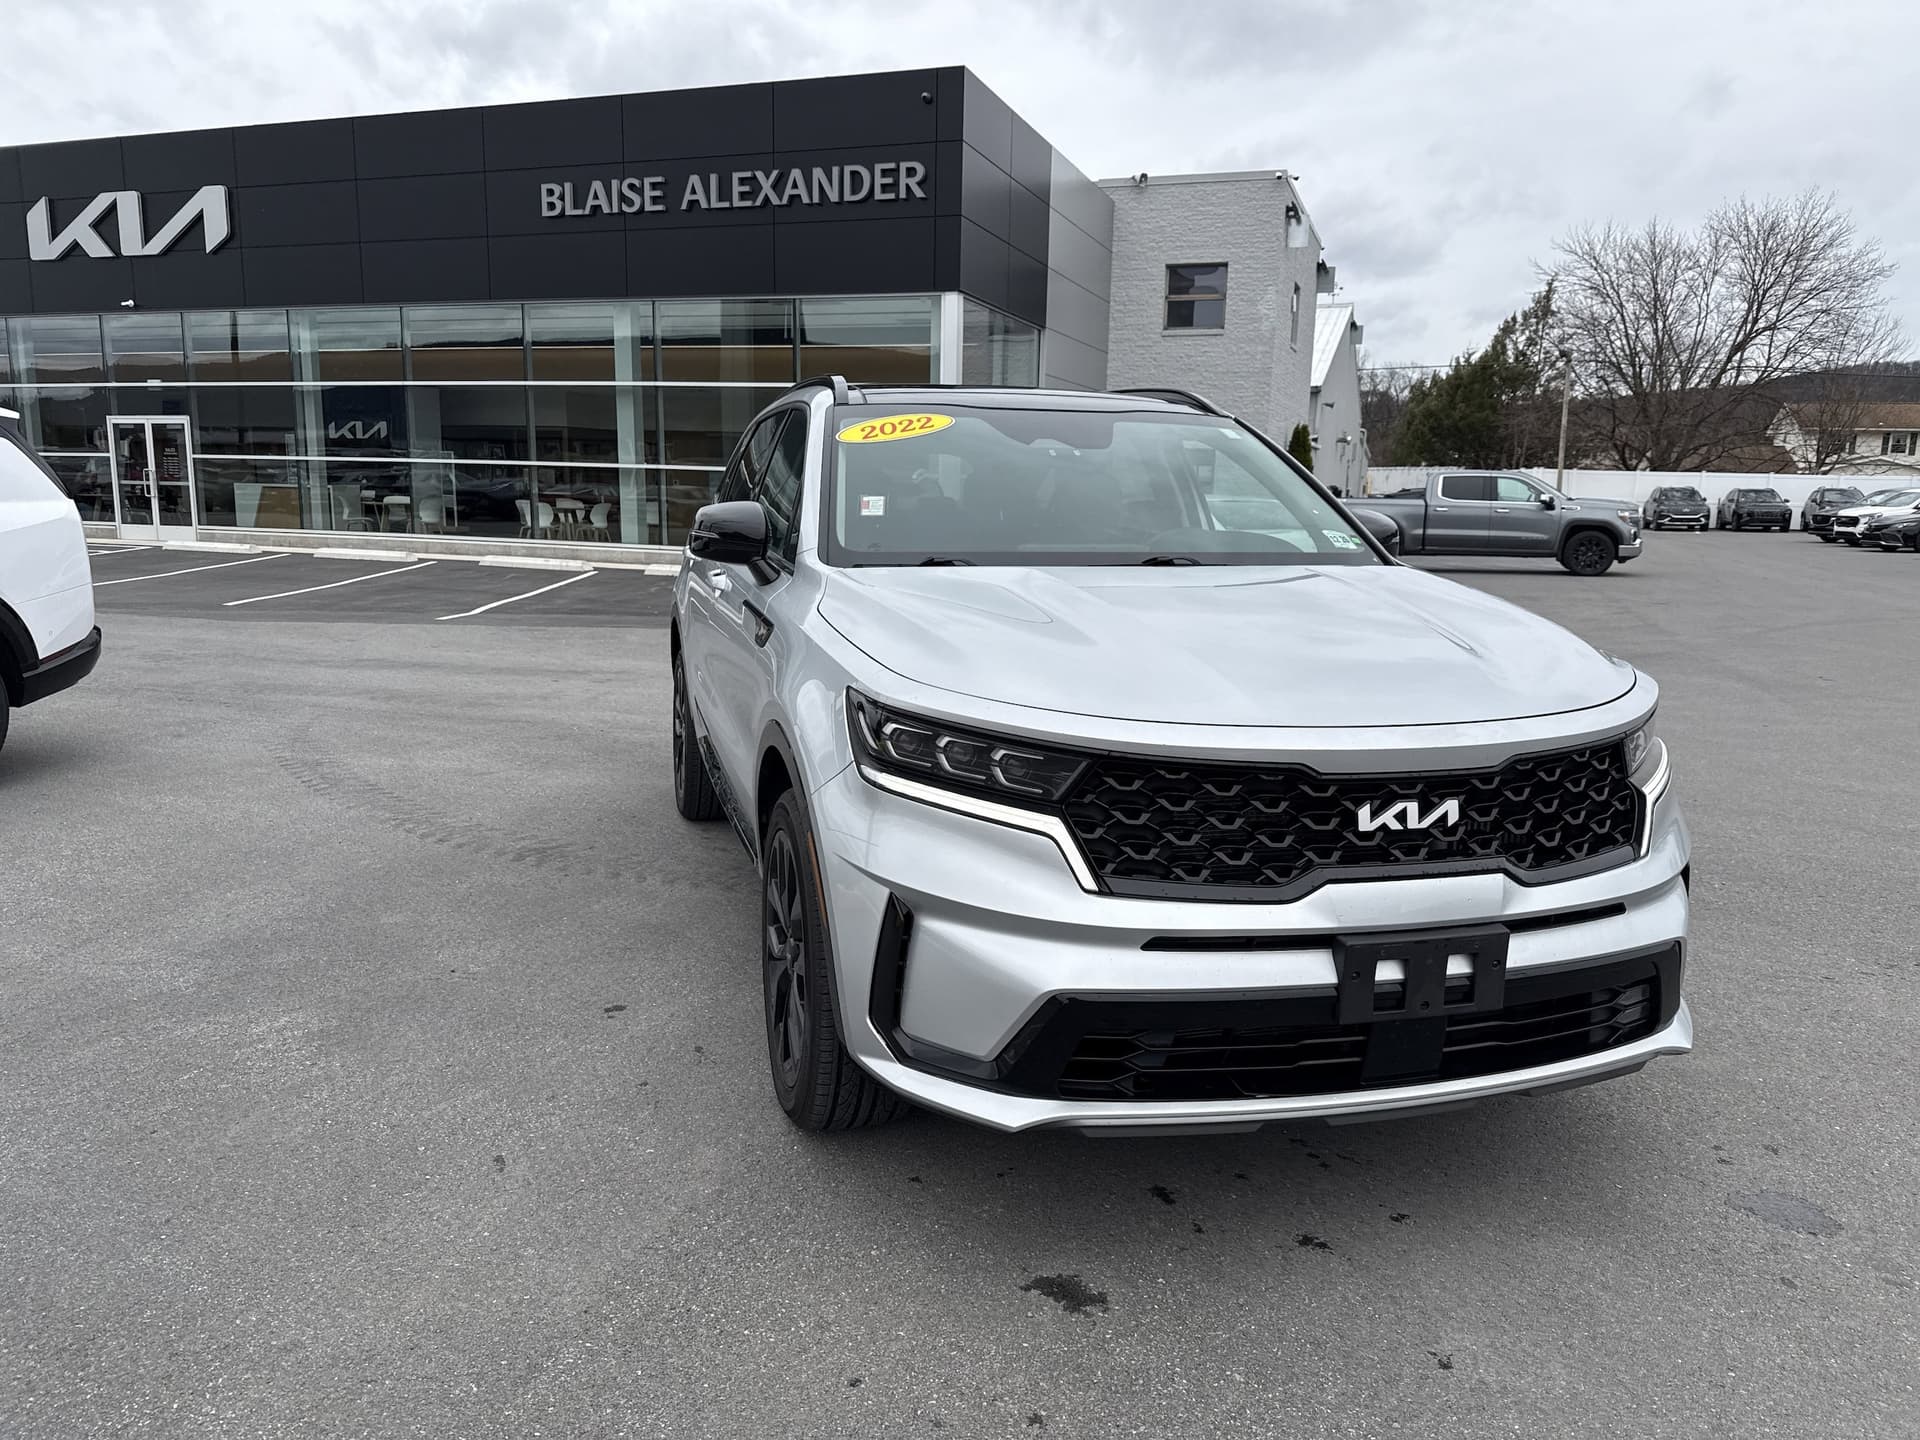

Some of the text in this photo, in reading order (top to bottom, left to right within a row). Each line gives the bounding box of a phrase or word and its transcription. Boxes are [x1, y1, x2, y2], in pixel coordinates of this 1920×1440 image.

[540, 161, 927, 217] BLAISE ALEXANDER
[26, 184, 230, 261] KIA
[328, 420, 388, 439] KIA
[860, 416, 935, 440] 2022
[1356, 797, 1460, 832] KIA
